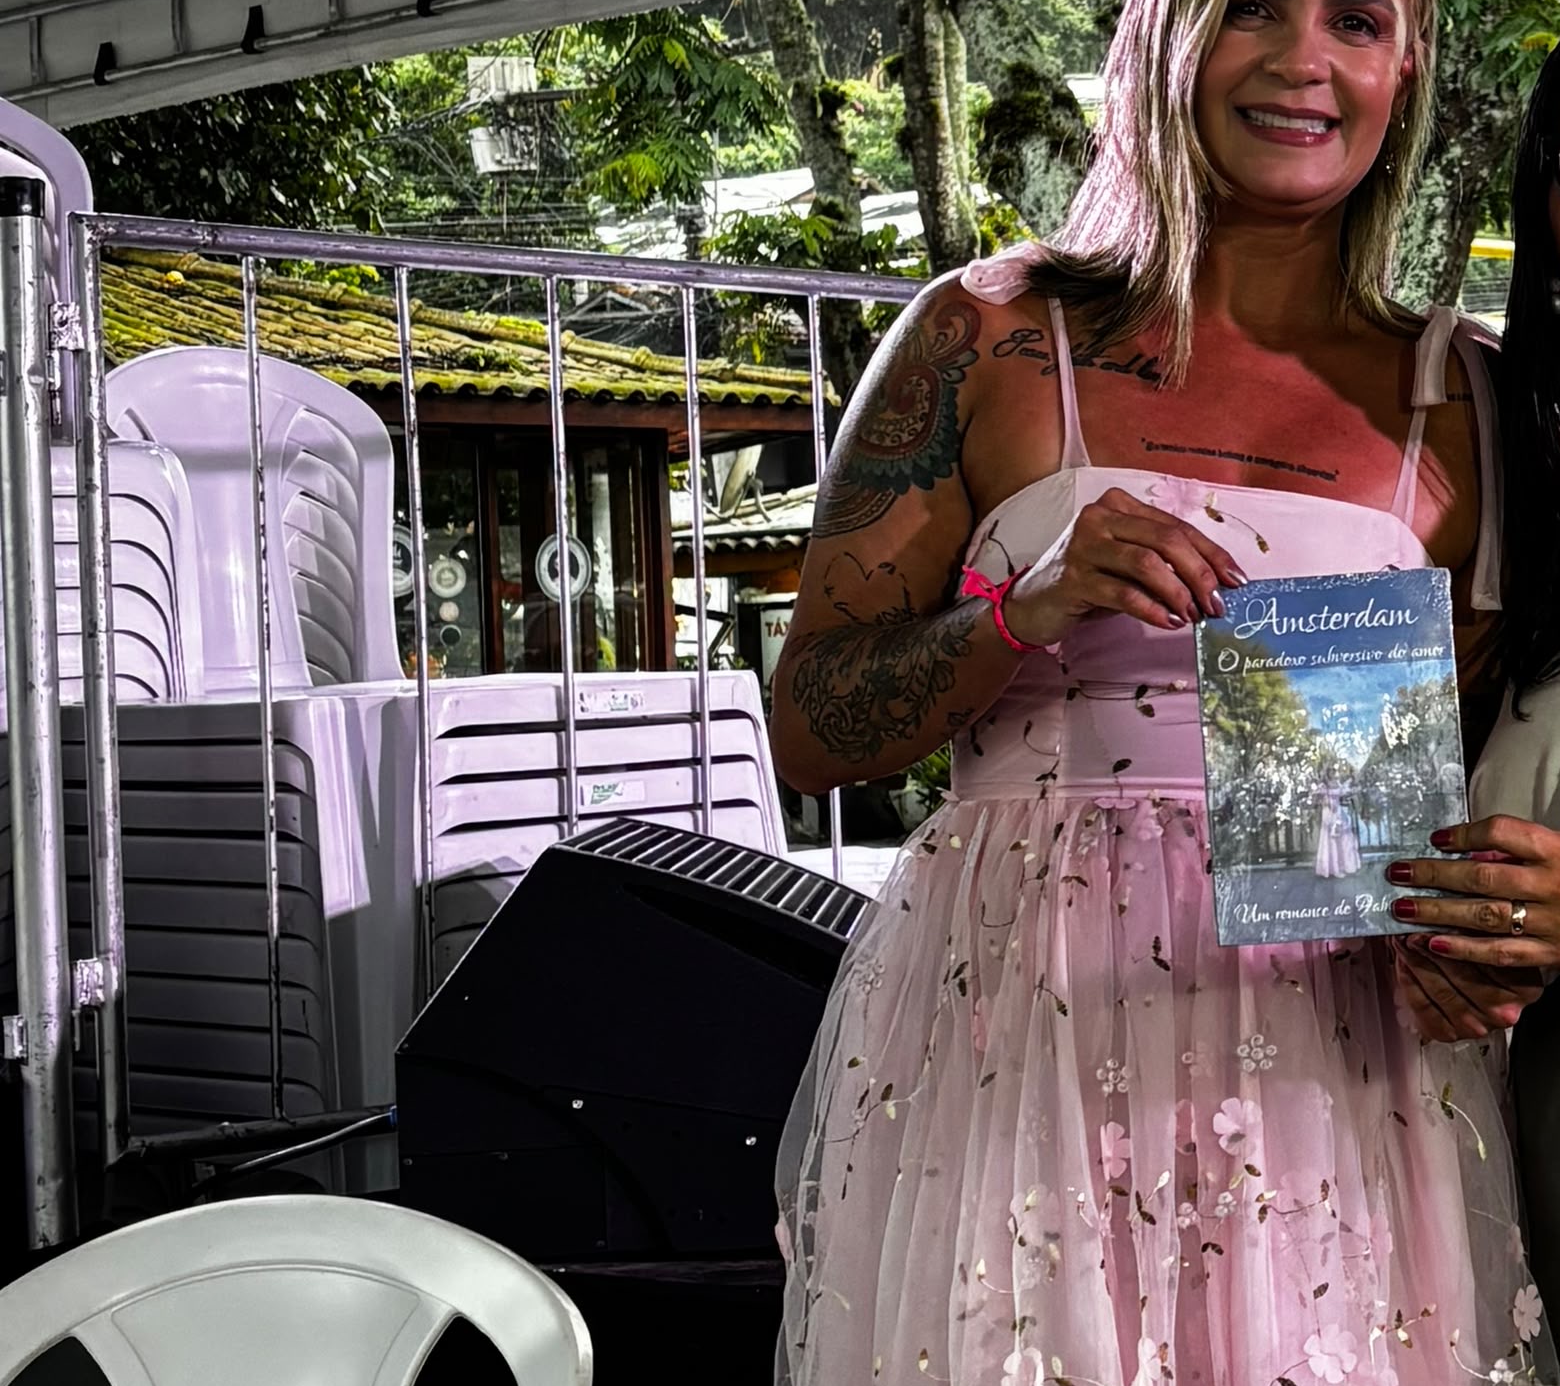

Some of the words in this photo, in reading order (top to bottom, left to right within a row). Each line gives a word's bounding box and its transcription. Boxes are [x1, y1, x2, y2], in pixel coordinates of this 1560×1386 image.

[1234, 597, 1419, 640] Amsterdam
[1218, 647, 1240, 672] O
[1242, 650, 1307, 677] paradoxo
[1310, 644, 1384, 666] subversivo
[1387, 642, 1408, 659] do
[1411, 644, 1446, 658] amor
[1233, 903, 1270, 924] Um
[1275, 906, 1329, 920] romance
[1334, 898, 1351, 916] de
